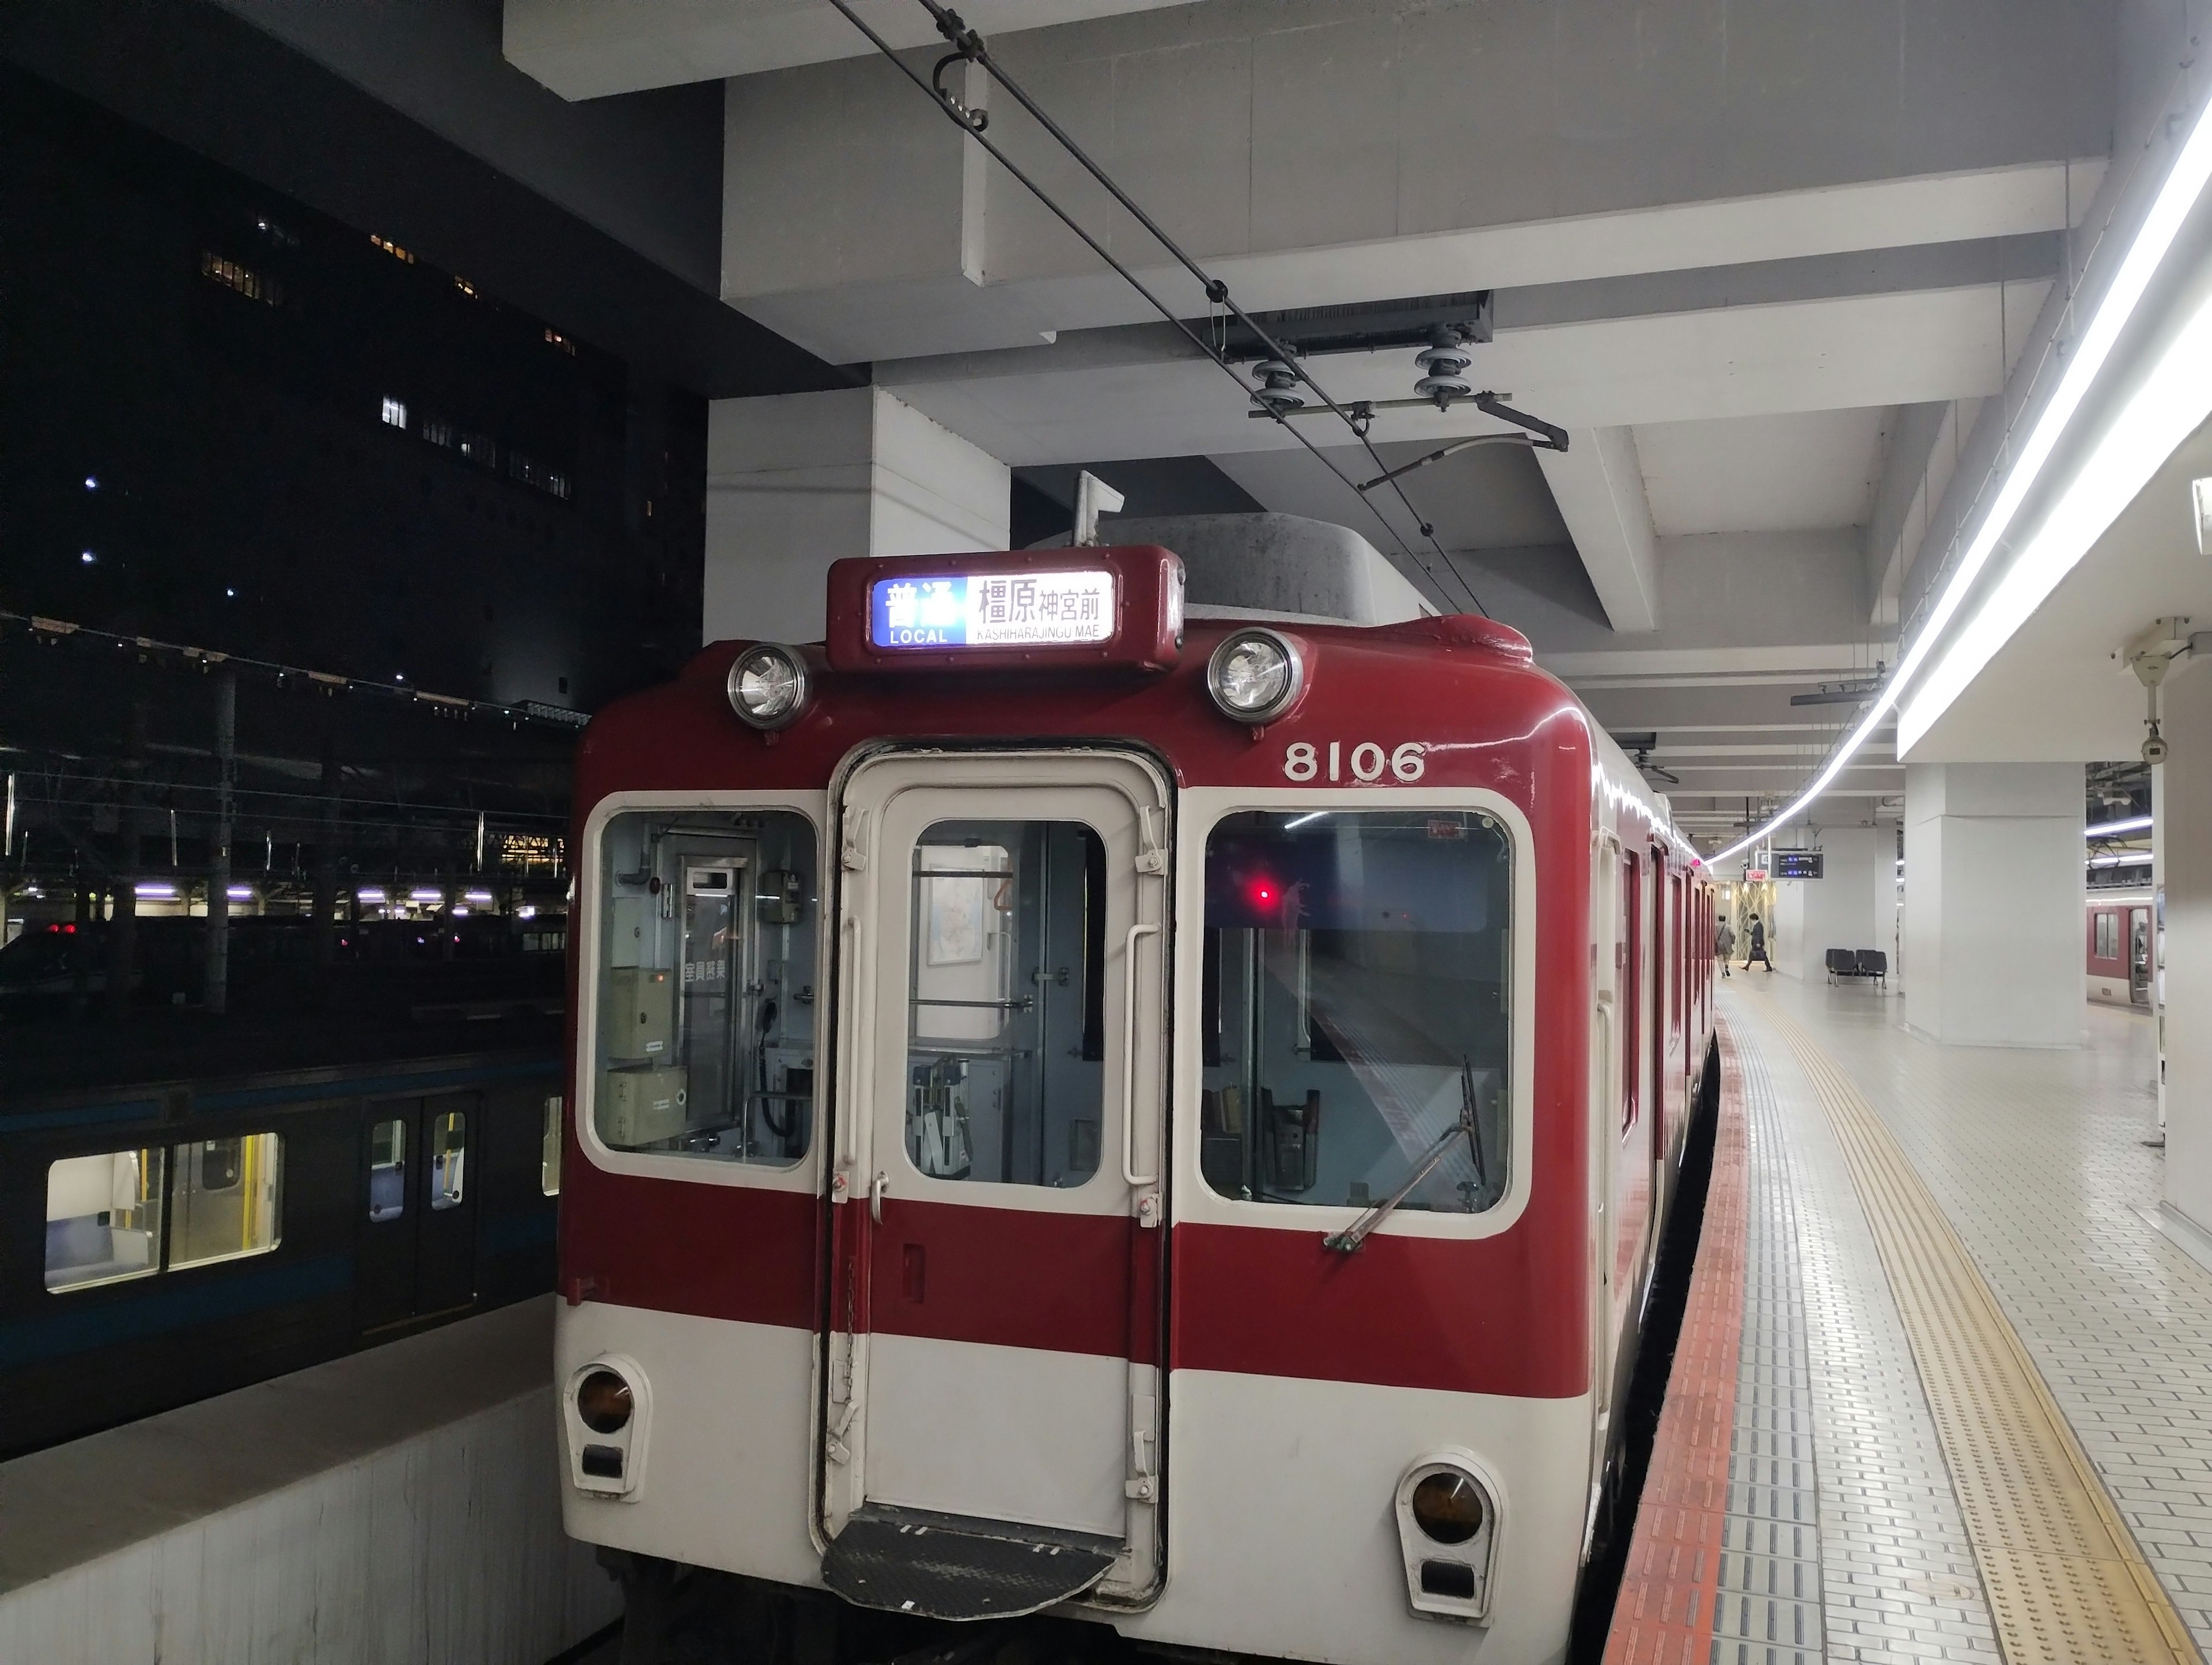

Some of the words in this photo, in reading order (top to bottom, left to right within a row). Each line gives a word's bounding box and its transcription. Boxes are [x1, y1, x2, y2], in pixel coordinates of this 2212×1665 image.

[979, 579, 1100, 624] 橿原神宮前
[890, 629, 948, 644] LOCAL
[977, 625, 1071, 640] KASHIHARAJINGU
[1075, 624, 1100, 638] MAE
[1284, 742, 1426, 781] 8106
